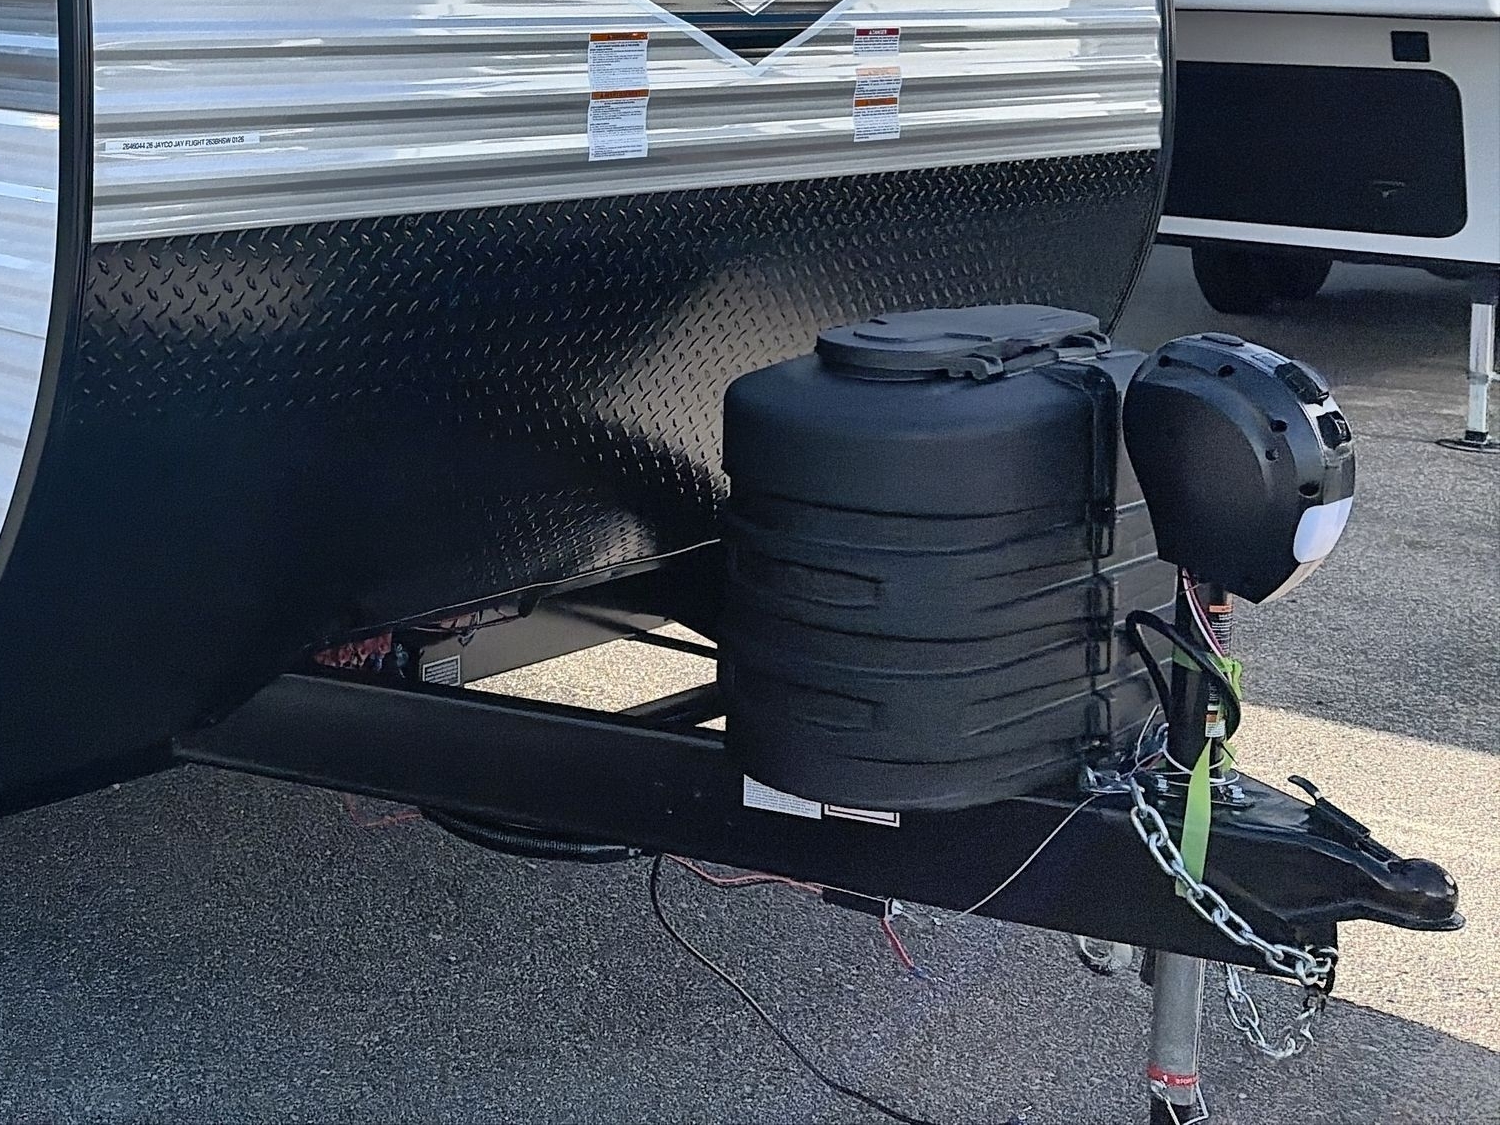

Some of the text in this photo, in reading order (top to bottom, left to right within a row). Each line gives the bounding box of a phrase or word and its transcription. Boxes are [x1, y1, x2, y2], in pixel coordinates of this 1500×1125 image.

[154, 140, 174, 148] JAYCO
[174, 140, 185, 148] JAY
[185, 138, 205, 147] FLIGHT
